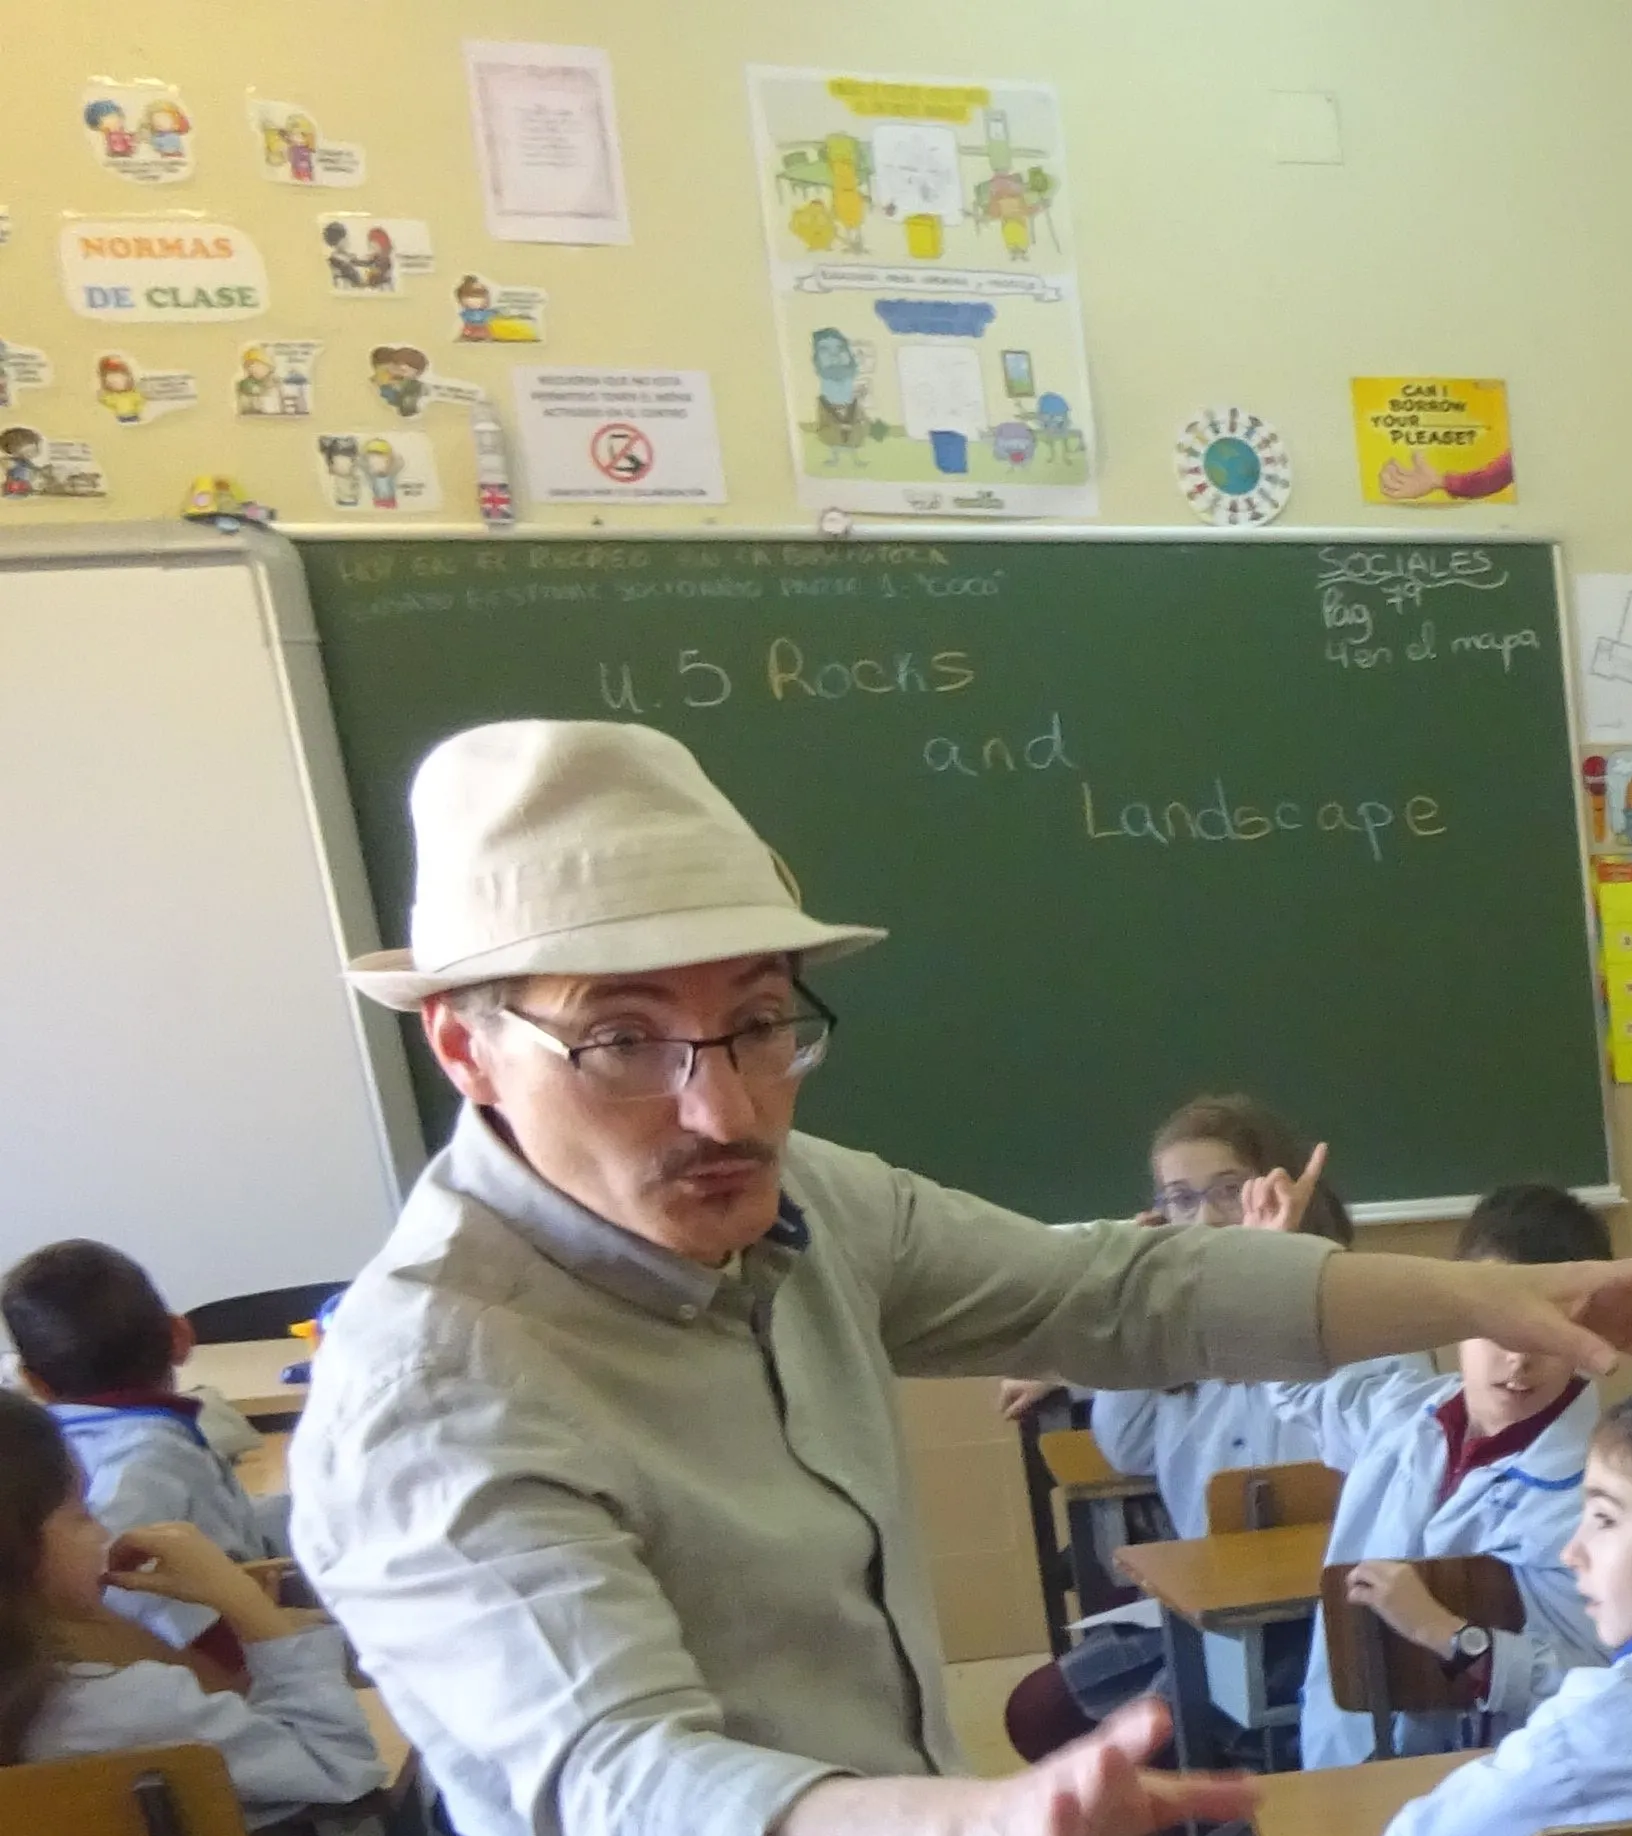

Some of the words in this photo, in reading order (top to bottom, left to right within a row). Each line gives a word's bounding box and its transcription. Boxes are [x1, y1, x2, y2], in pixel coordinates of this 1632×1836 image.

[80, 236, 234, 259] NORMAS
[85, 285, 135, 309] DE
[144, 285, 260, 309] CLASE
[1402, 384, 1436, 397] CAN
[1388, 398, 1467, 412] BORROW
[1390, 429, 1477, 445] PLEASE?
[1317, 546, 1493, 578] SOCIALES
[1451, 629, 1541, 674] mapa
[679, 649, 732, 706] 5
[768, 637, 974, 700] Rocks
[923, 711, 1081, 775] and
[1082, 777, 1447, 862] Landscape
